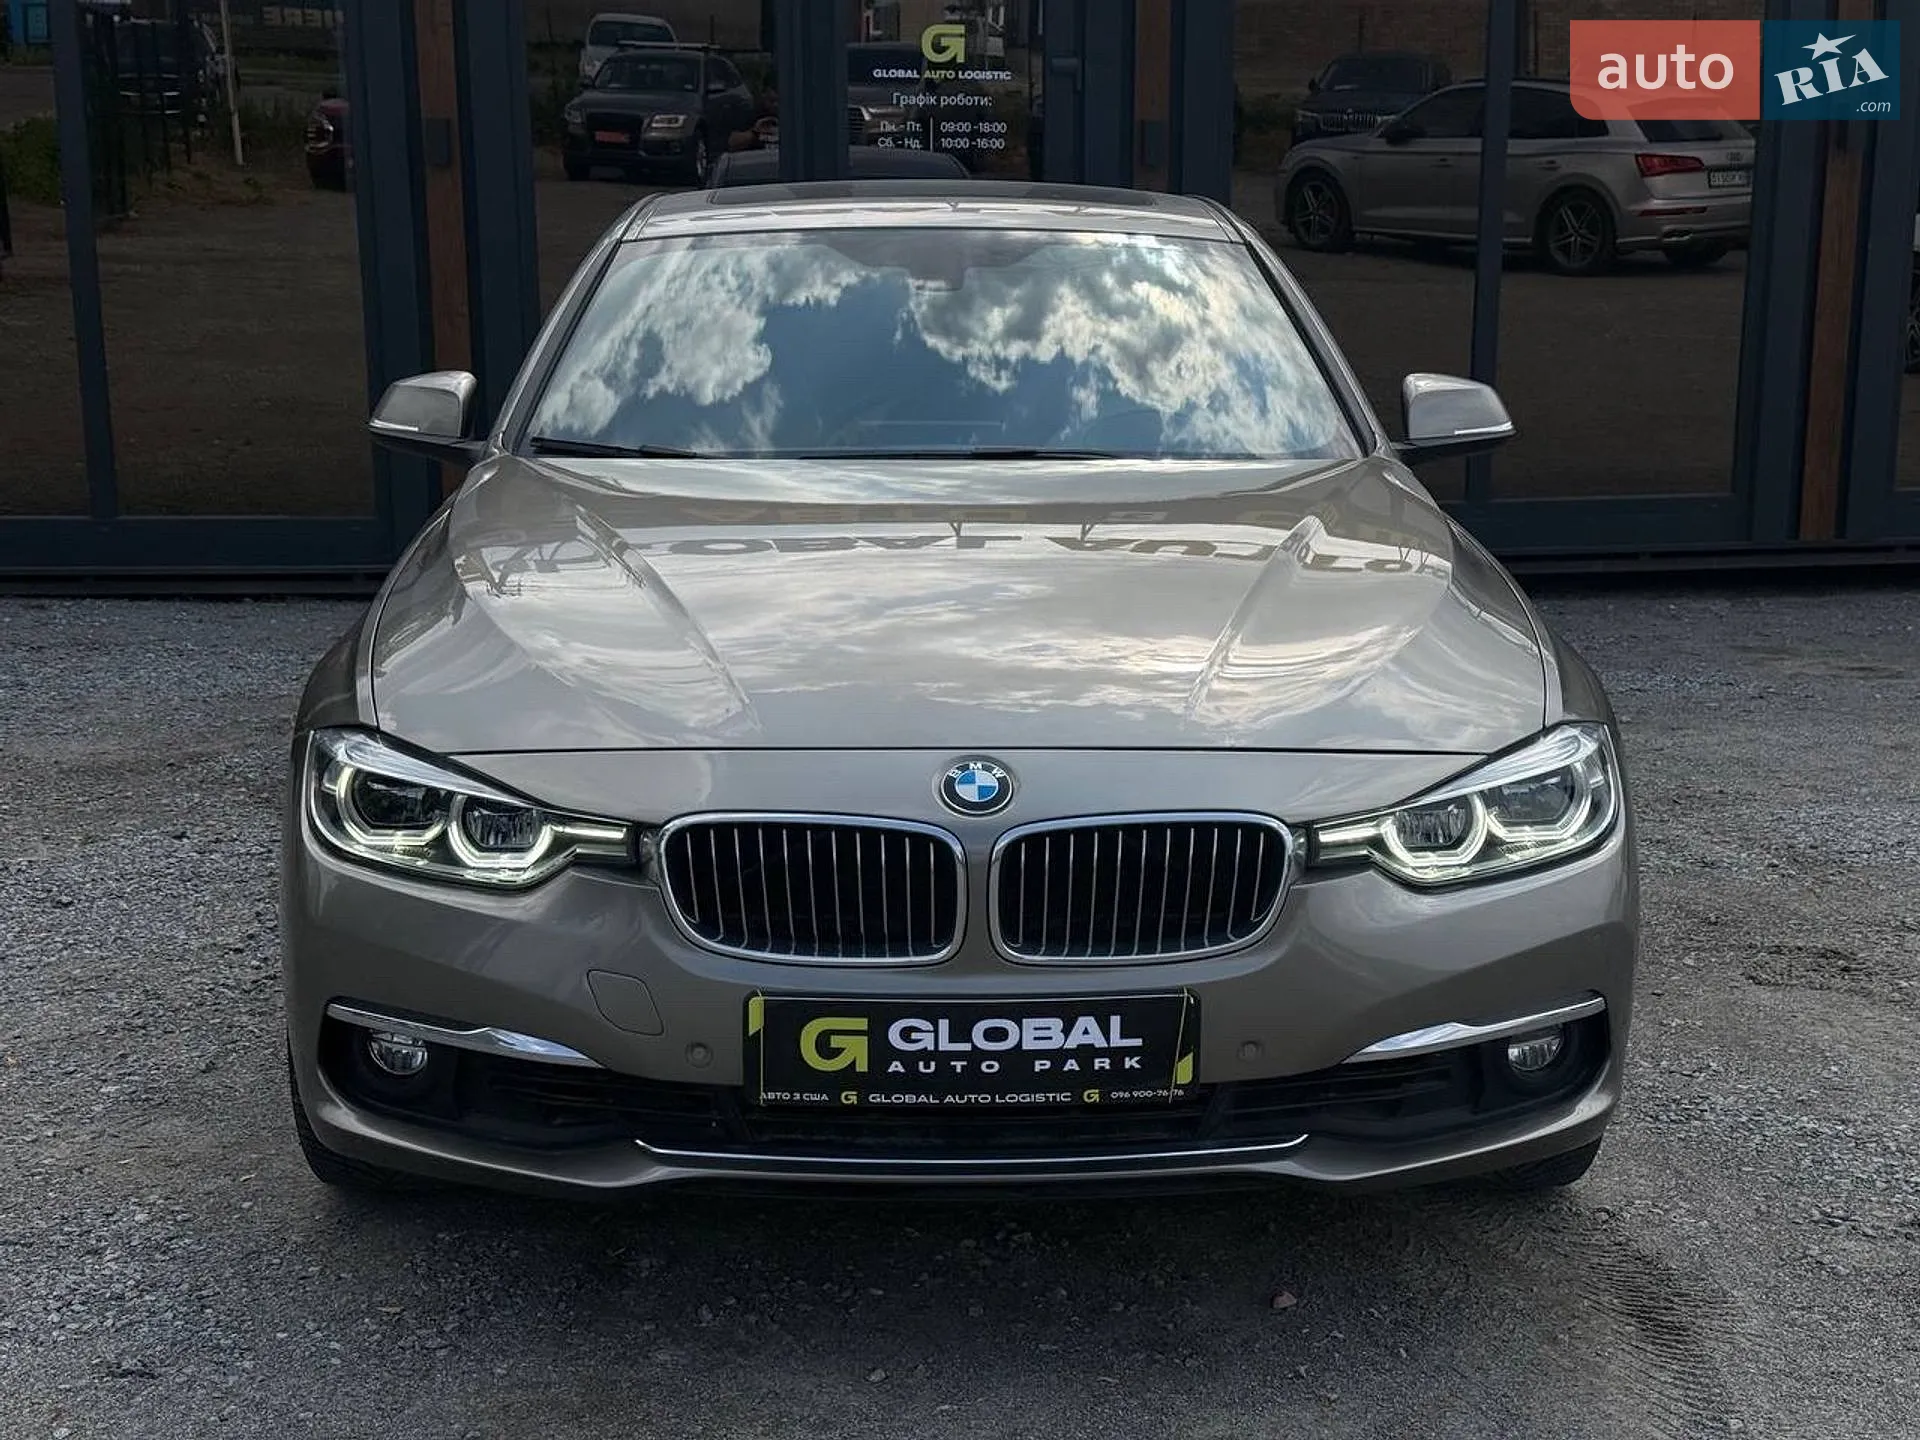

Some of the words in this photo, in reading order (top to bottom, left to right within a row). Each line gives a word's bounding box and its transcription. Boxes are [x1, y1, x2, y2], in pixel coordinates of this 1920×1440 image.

[873, 69, 920, 79] GLOBAL
[923, 70, 955, 79] AUTO
[958, 70, 1012, 80] LOGISTIC
[892, 92, 937, 108] Графік
[940, 93, 993, 108] роботи:
[906, 121, 923, 132] Пт.
[940, 122, 971, 133] 09:00
[904, 138, 923, 149] Нд.
[940, 138, 970, 149] 10:00
[888, 1015, 1143, 1052] GLOBAL
[887, 1060, 1000, 1073] AUTO
[1035, 1056, 1143, 1071] PARK
[802, 1093, 829, 1101] США
[868, 1093, 939, 1104] GLOBAL
[943, 1093, 991, 1104] AUTO
[996, 1092, 1072, 1103] LOGISTIC
[1132, 1089, 1185, 1098] 900-7676
